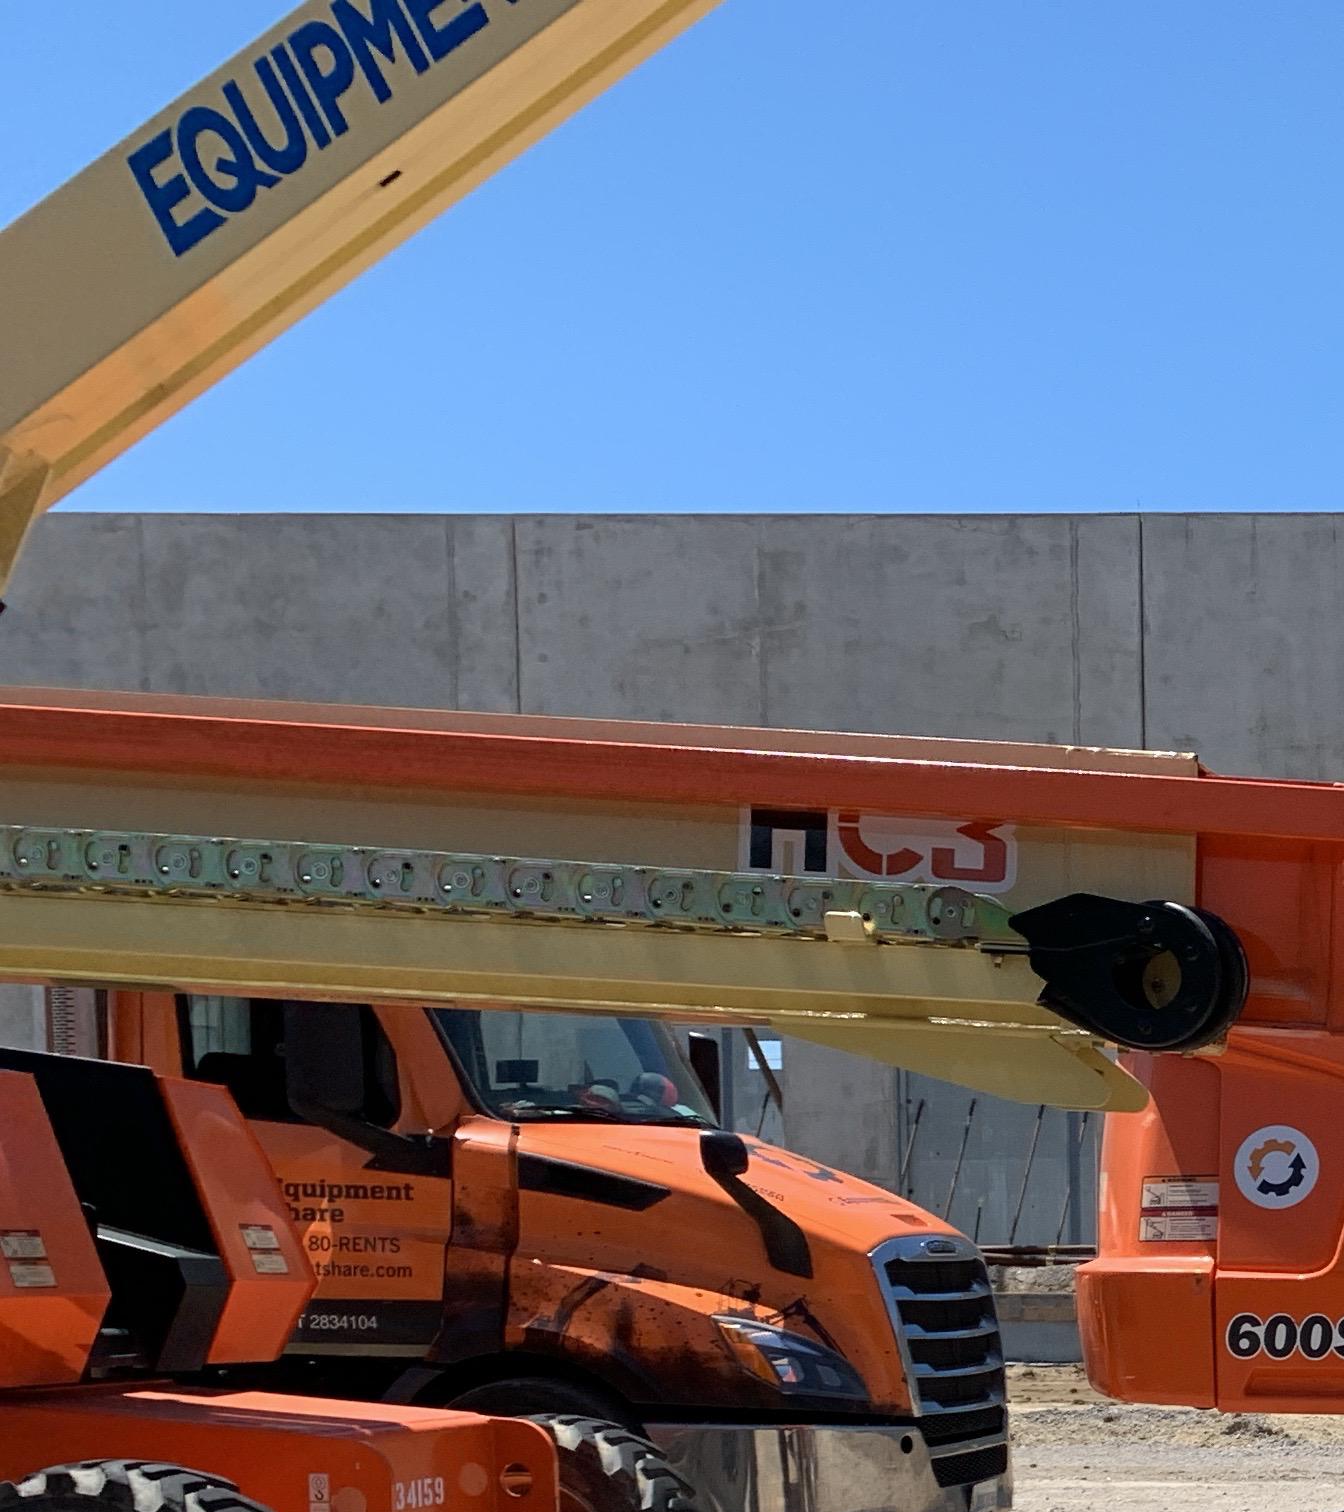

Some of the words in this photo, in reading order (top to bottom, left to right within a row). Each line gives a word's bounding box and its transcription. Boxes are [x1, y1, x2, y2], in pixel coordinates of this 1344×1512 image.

[127, 0, 516, 257] EQUIPME
[280, 1179, 414, 1202] quipment
[287, 1203, 345, 1223] hare
[308, 1235, 401, 1253] 80-RENTS
[314, 1261, 413, 1278] tshare.com
[310, 1314, 378, 1330] 2834104
[395, 1477, 445, 1510] 34159
